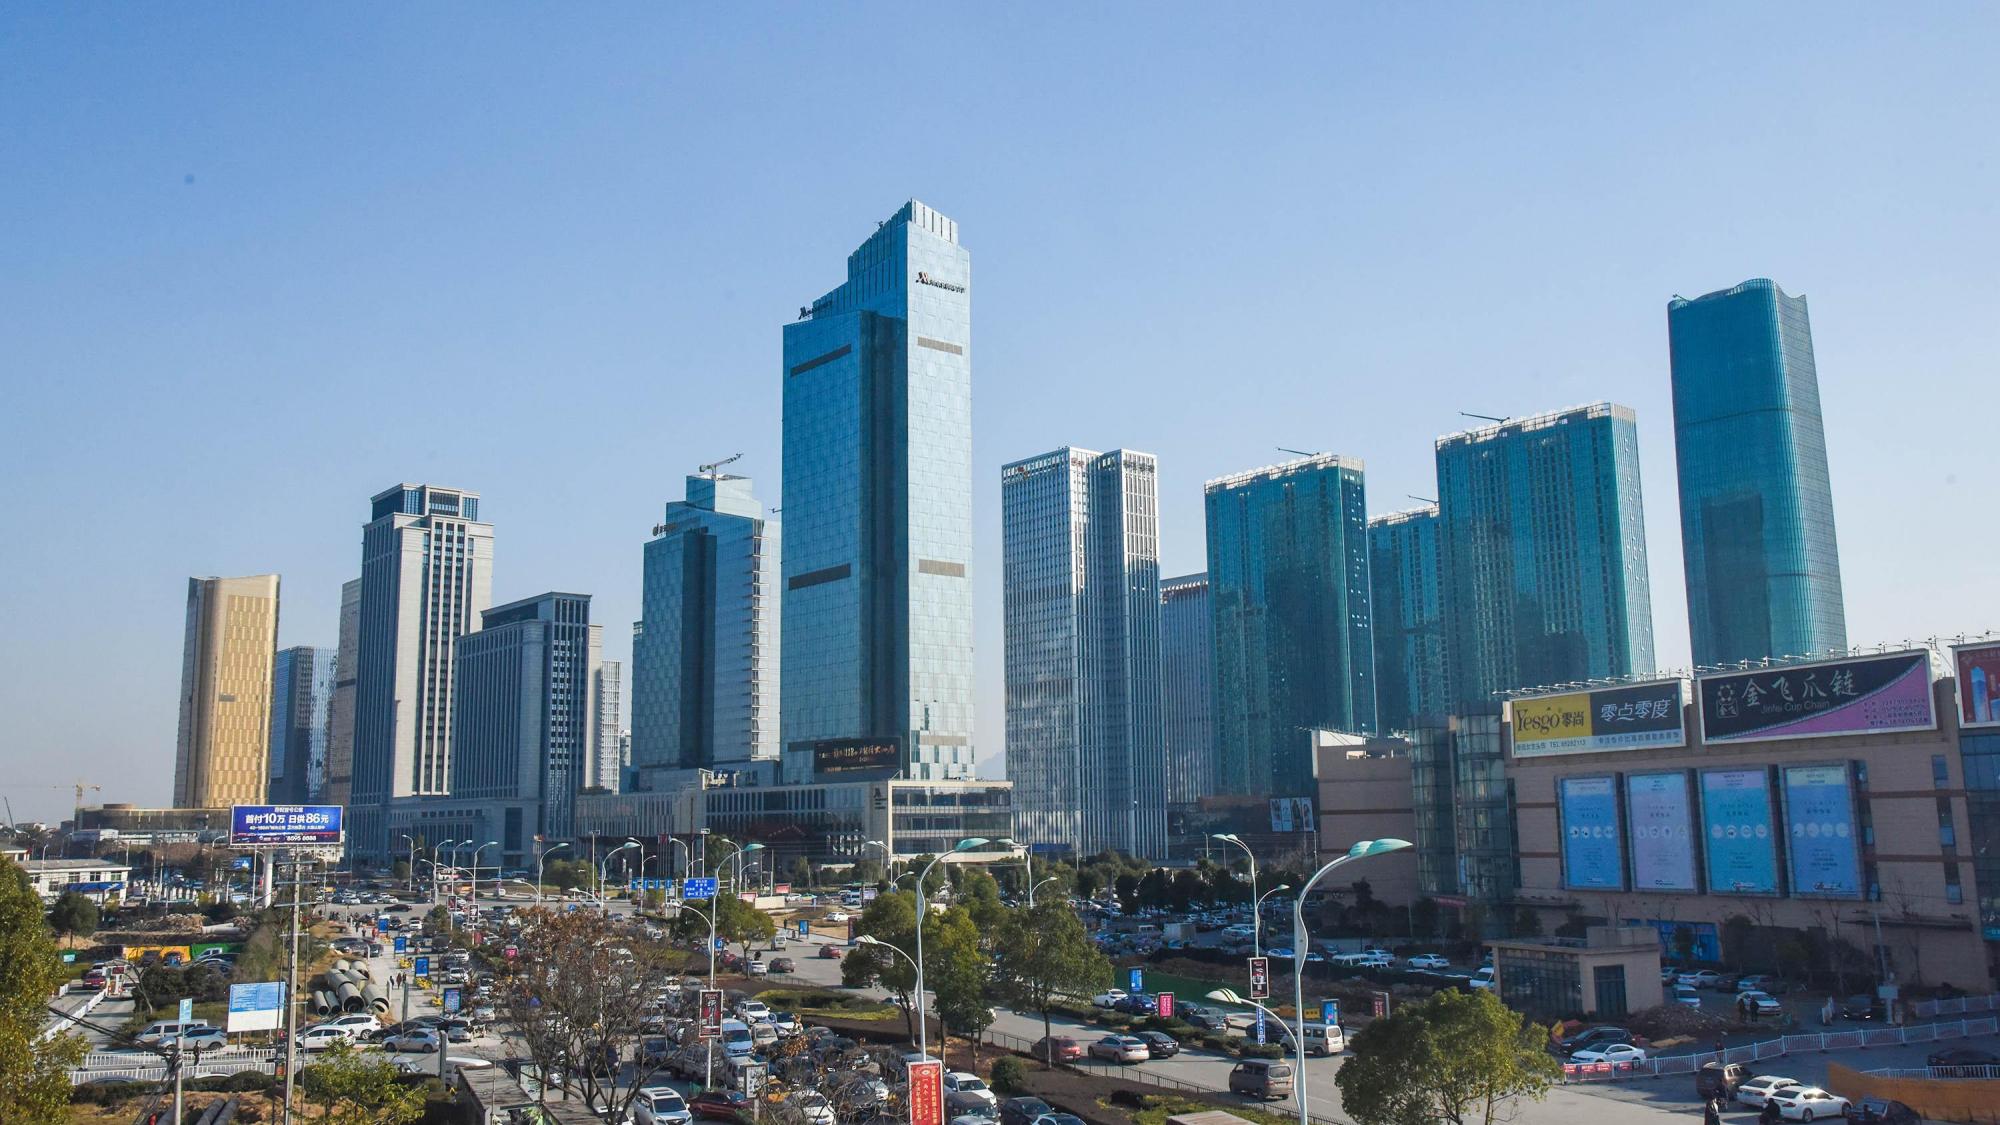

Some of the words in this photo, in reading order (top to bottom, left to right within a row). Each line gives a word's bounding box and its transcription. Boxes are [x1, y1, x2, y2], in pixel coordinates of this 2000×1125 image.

[1741, 669, 1860, 707] 金飞爪链
[1601, 698, 1671, 722] 零点零度
[1784, 702, 1801, 713] Cup
[1804, 700, 1830, 710] Chain
[1516, 707, 1560, 734] Yesgo
[1562, 710, 1585, 728] 零尚
[245, 813, 285, 824] 首付10万
[288, 813, 329, 824] 日供86元
